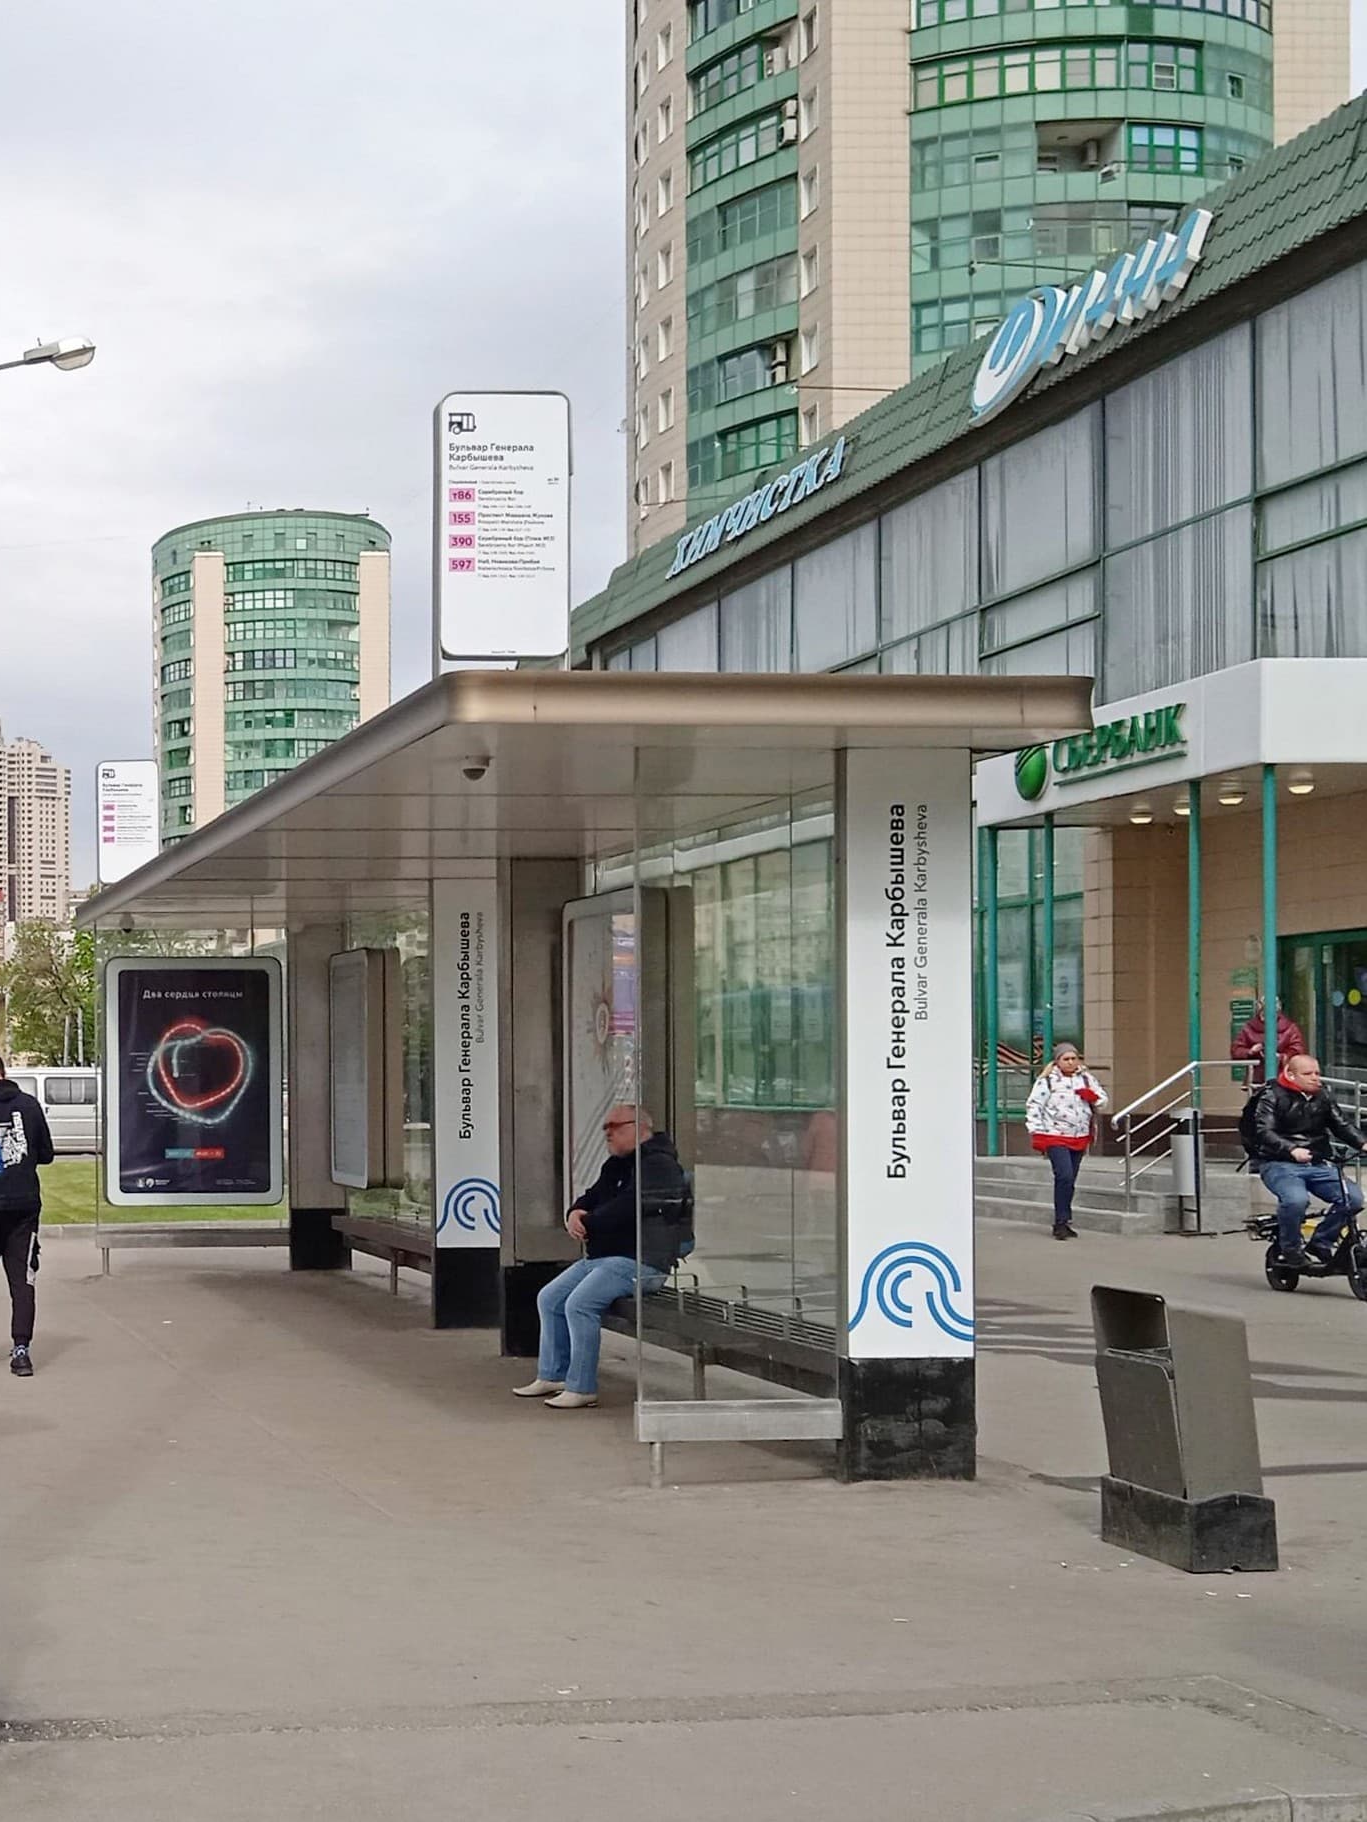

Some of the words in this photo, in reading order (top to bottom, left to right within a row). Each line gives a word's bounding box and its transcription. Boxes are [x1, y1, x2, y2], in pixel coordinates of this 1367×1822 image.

[449, 443, 488, 453] Бульвар
[490, 443, 534, 453] Генерала
[449, 453, 504, 462] Карбышева
[452, 513, 471, 524] 155
[452, 536, 472, 546] 390
[665, 436, 846, 580] ХИМЧИСТКА
[452, 560, 472, 570] 597
[1053, 703, 1188, 773] СБЕРБАНК
[885, 804, 909, 948] Карбышева
[913, 804, 930, 893] Karbysheva
[457, 911, 472, 1000] Карбышева
[913, 897, 928, 969] Generala
[143, 989, 162, 1000] Два
[164, 991, 200, 1000] сердца
[202, 991, 243, 999] столицы
[886, 956, 910, 1069] Генерала
[914, 973, 928, 1021] Bulvar
[458, 1004, 473, 1073] Генерала
[459, 1077, 474, 1140] Бульвар
[887, 1077, 911, 1179] Бульвар
